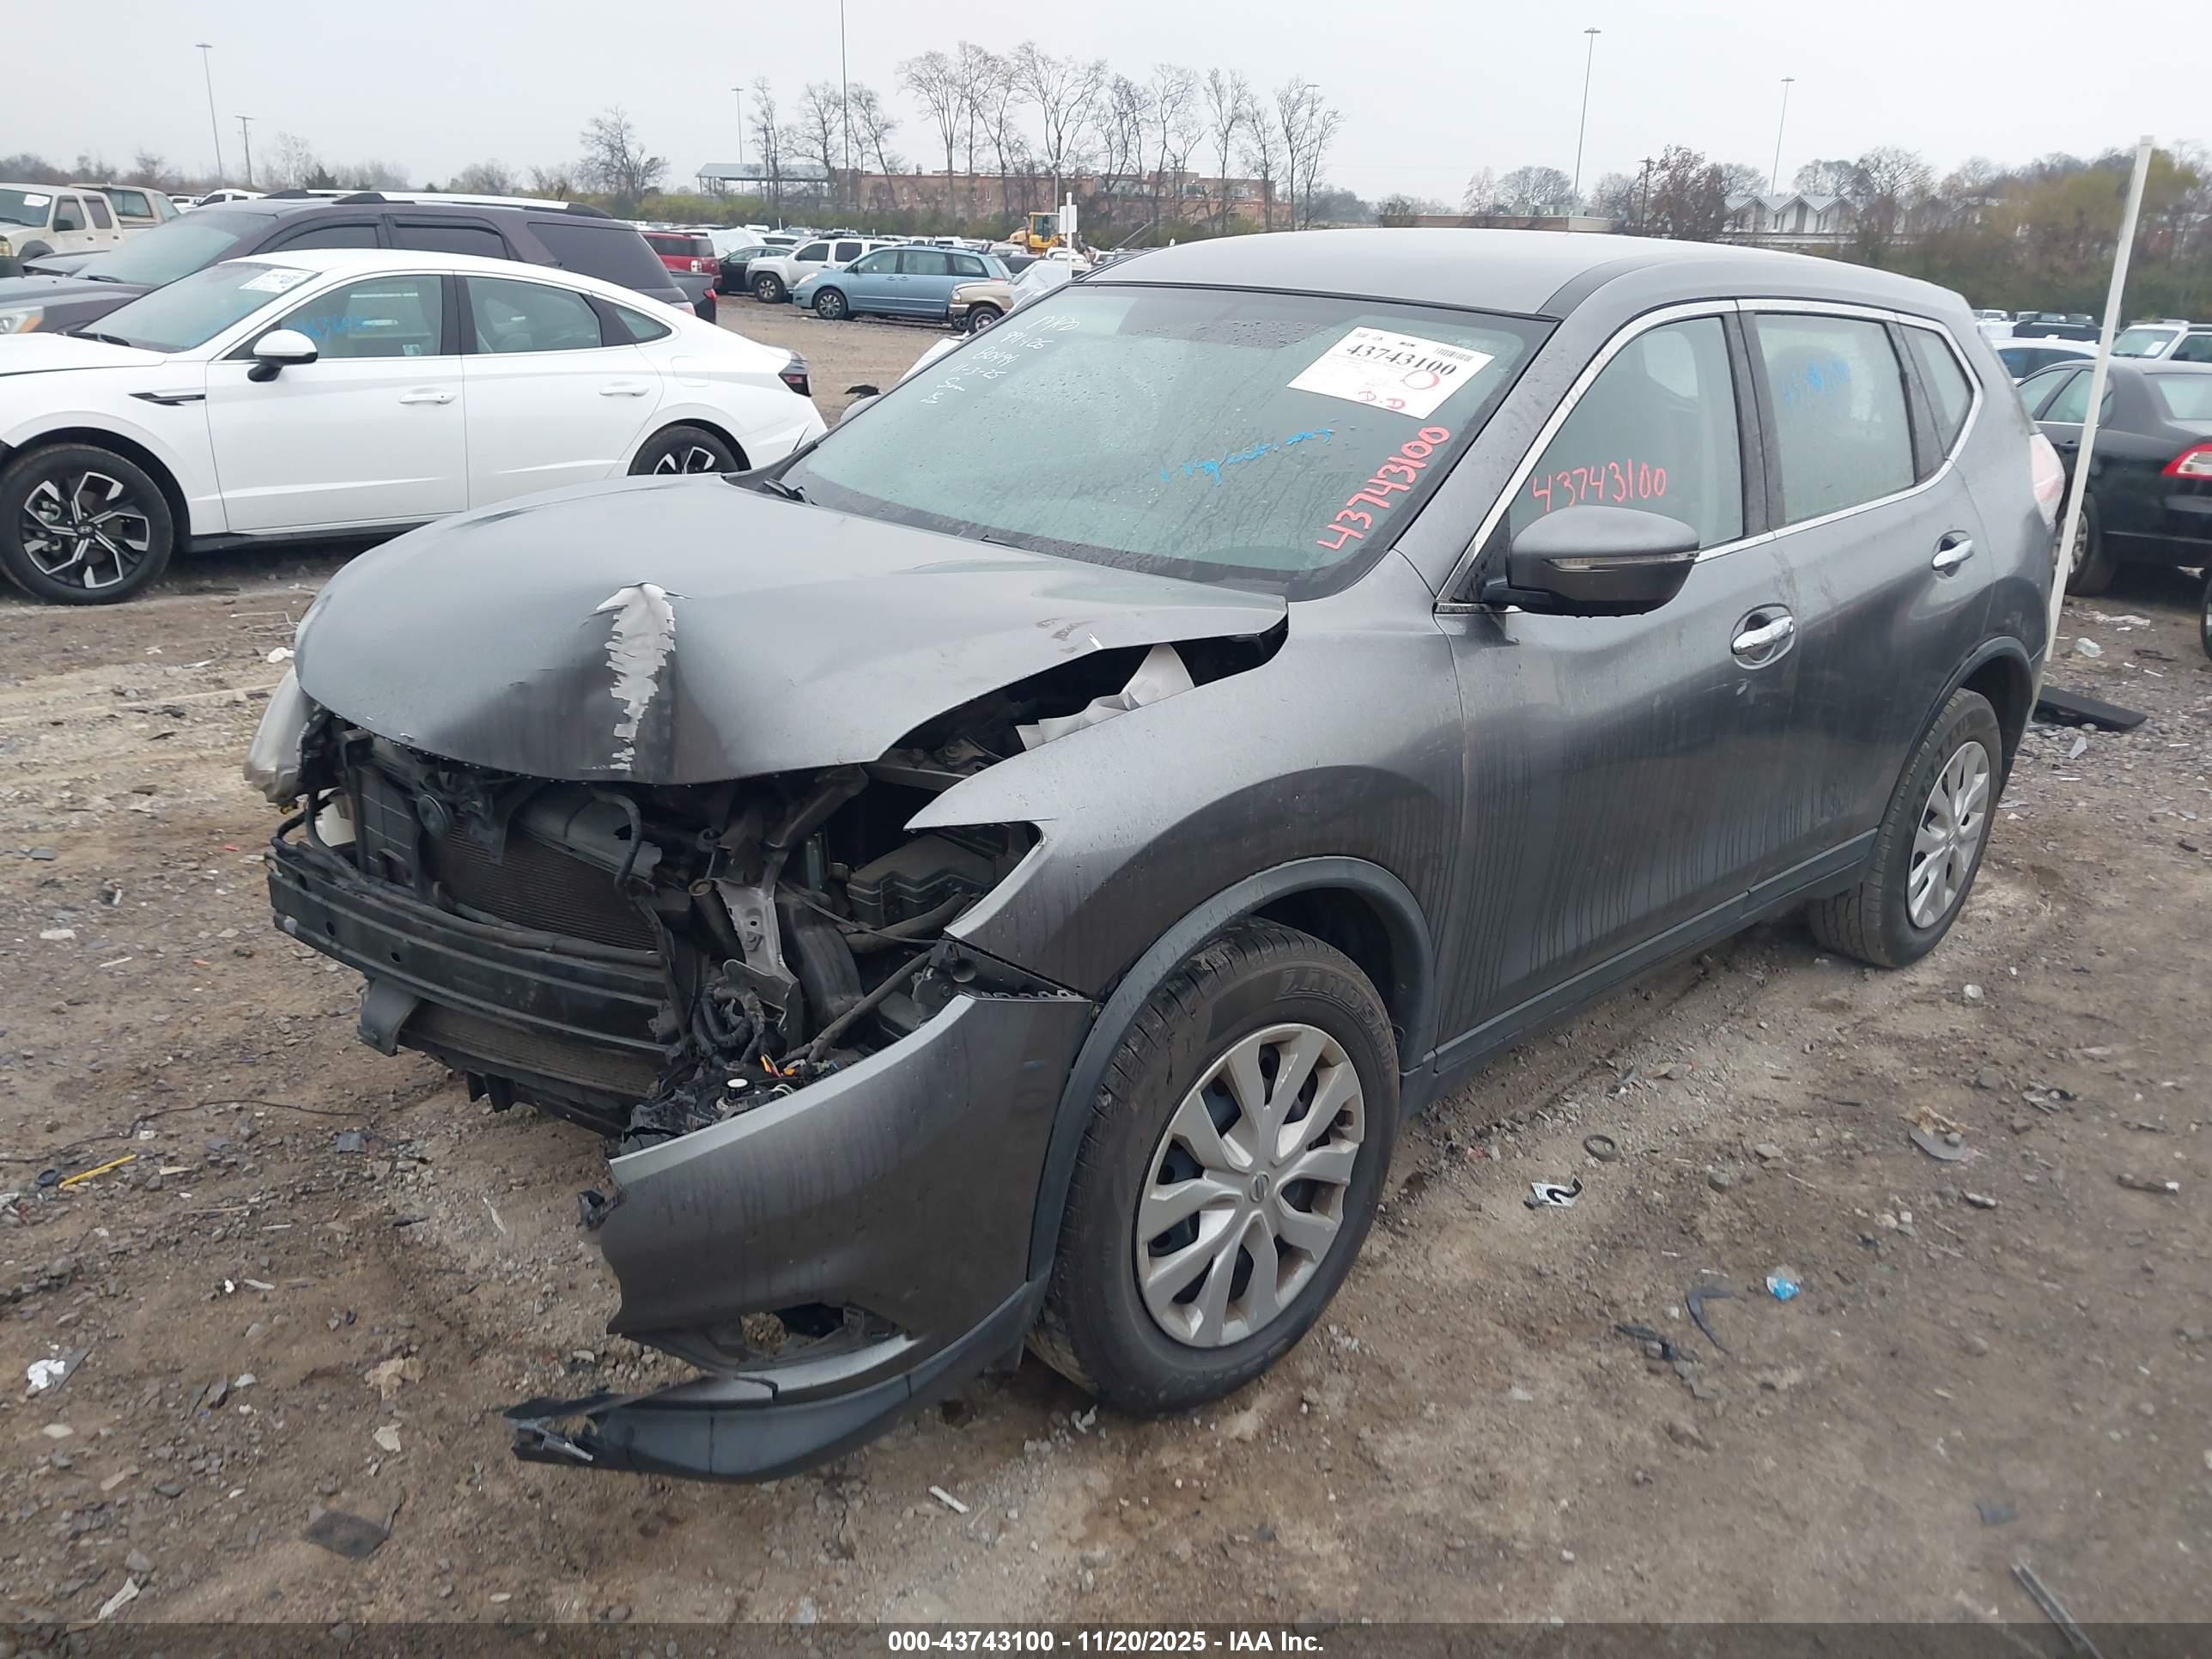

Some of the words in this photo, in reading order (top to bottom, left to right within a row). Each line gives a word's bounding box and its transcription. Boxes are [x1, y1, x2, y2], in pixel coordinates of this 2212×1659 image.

[1346, 343, 1458, 376] 43743100
[1316, 426, 1451, 550] 43743100
[1530, 458, 1668, 513] 43743100
